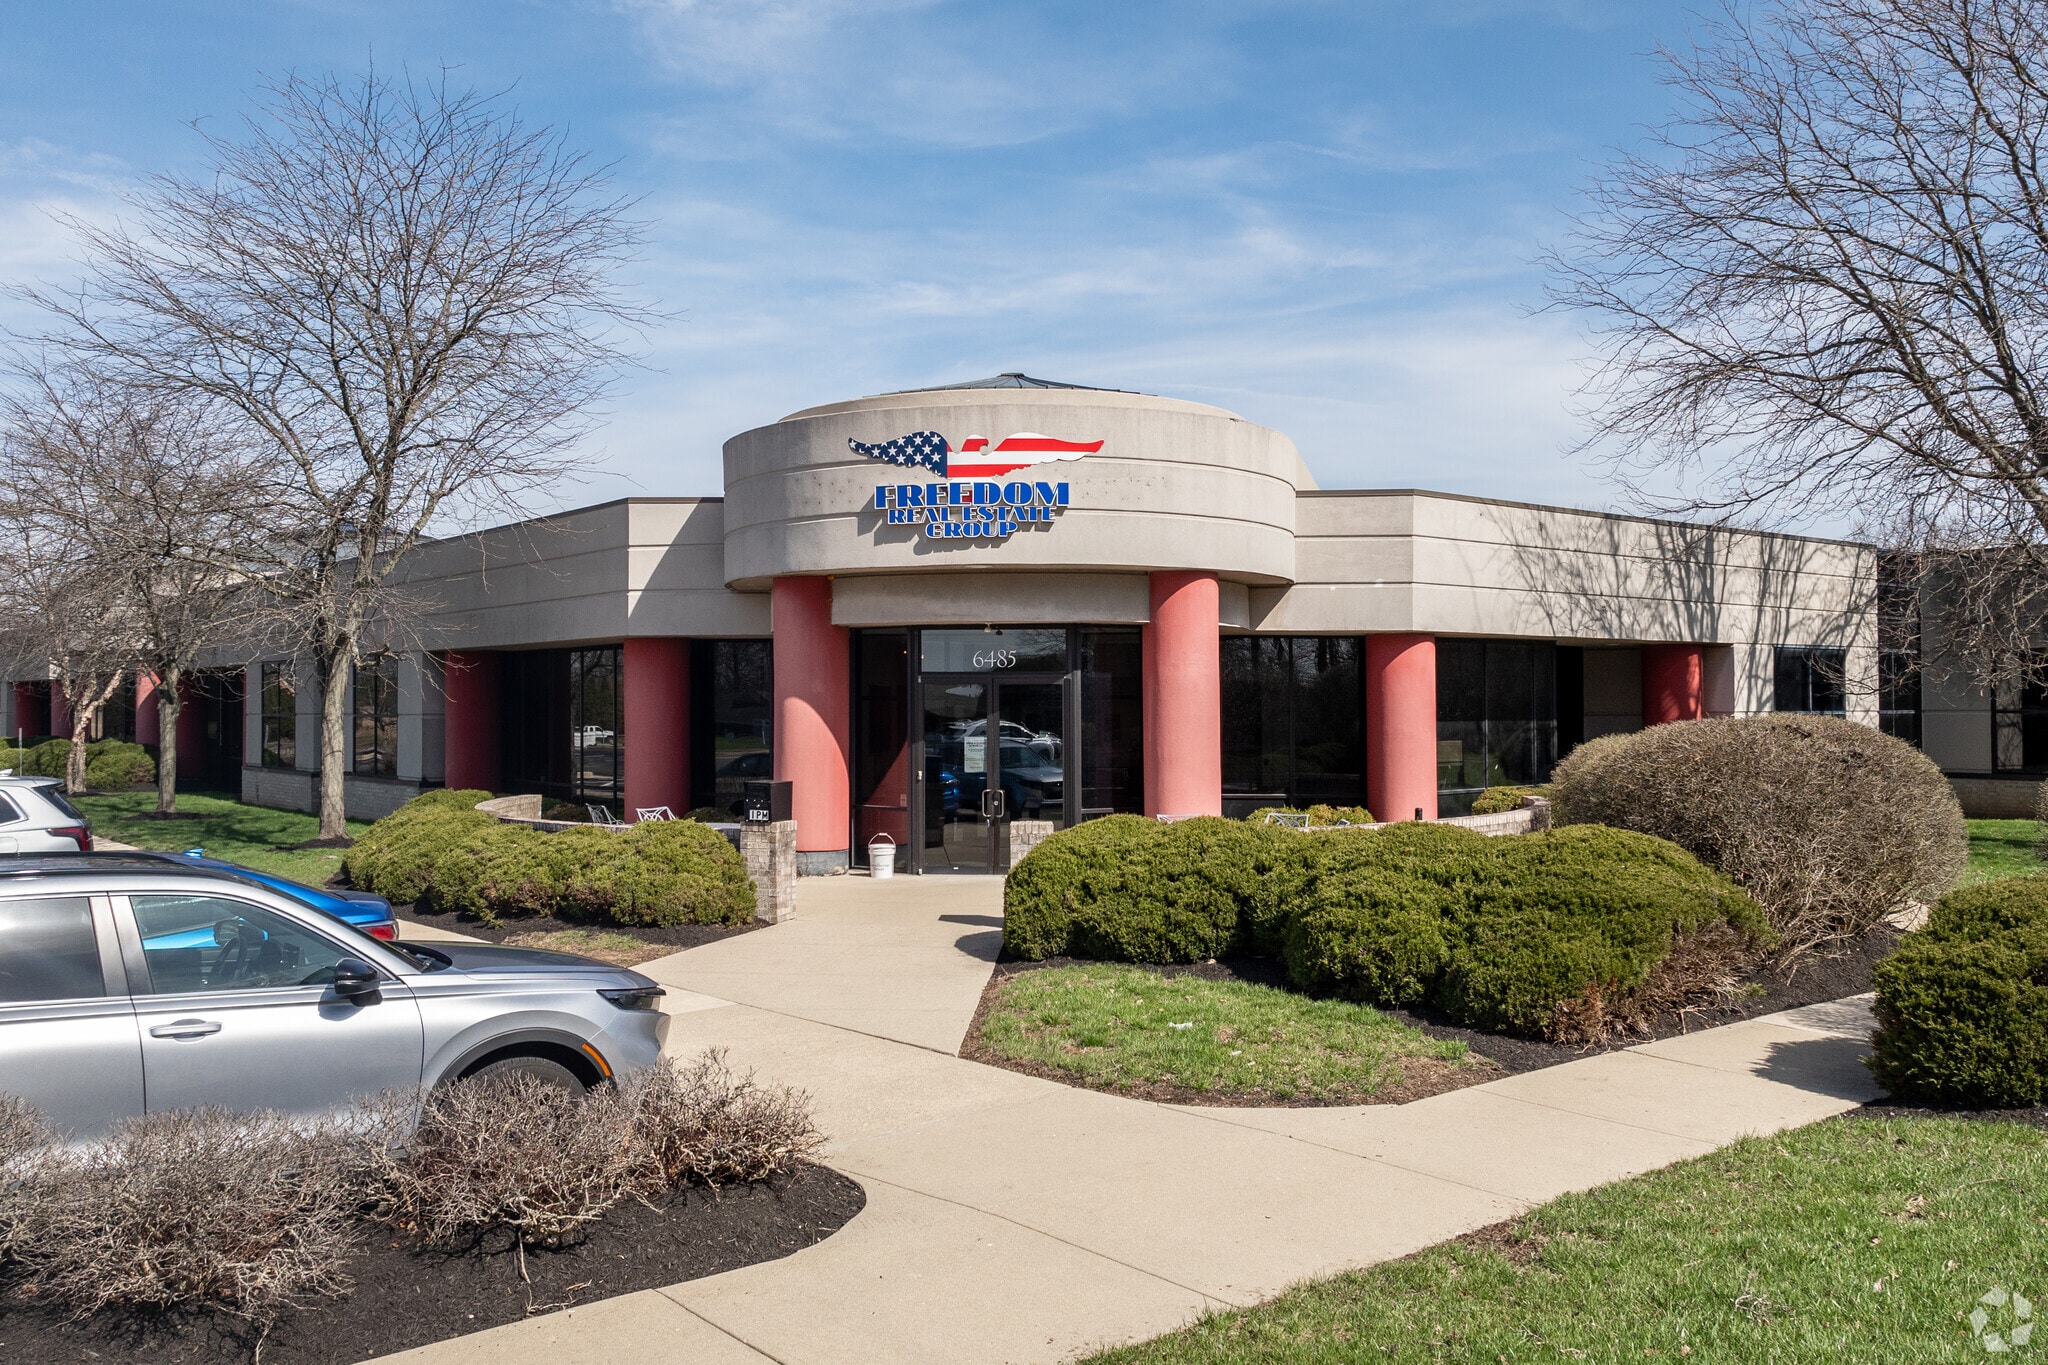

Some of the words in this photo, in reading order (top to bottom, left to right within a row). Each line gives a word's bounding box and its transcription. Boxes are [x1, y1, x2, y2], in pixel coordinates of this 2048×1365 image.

[875, 482, 1069, 509] FREEDOM
[888, 507, 954, 524] REAL
[963, 506, 1056, 522] ESTATE
[925, 521, 1018, 538] GROUP
[973, 649, 1017, 668] 6485
